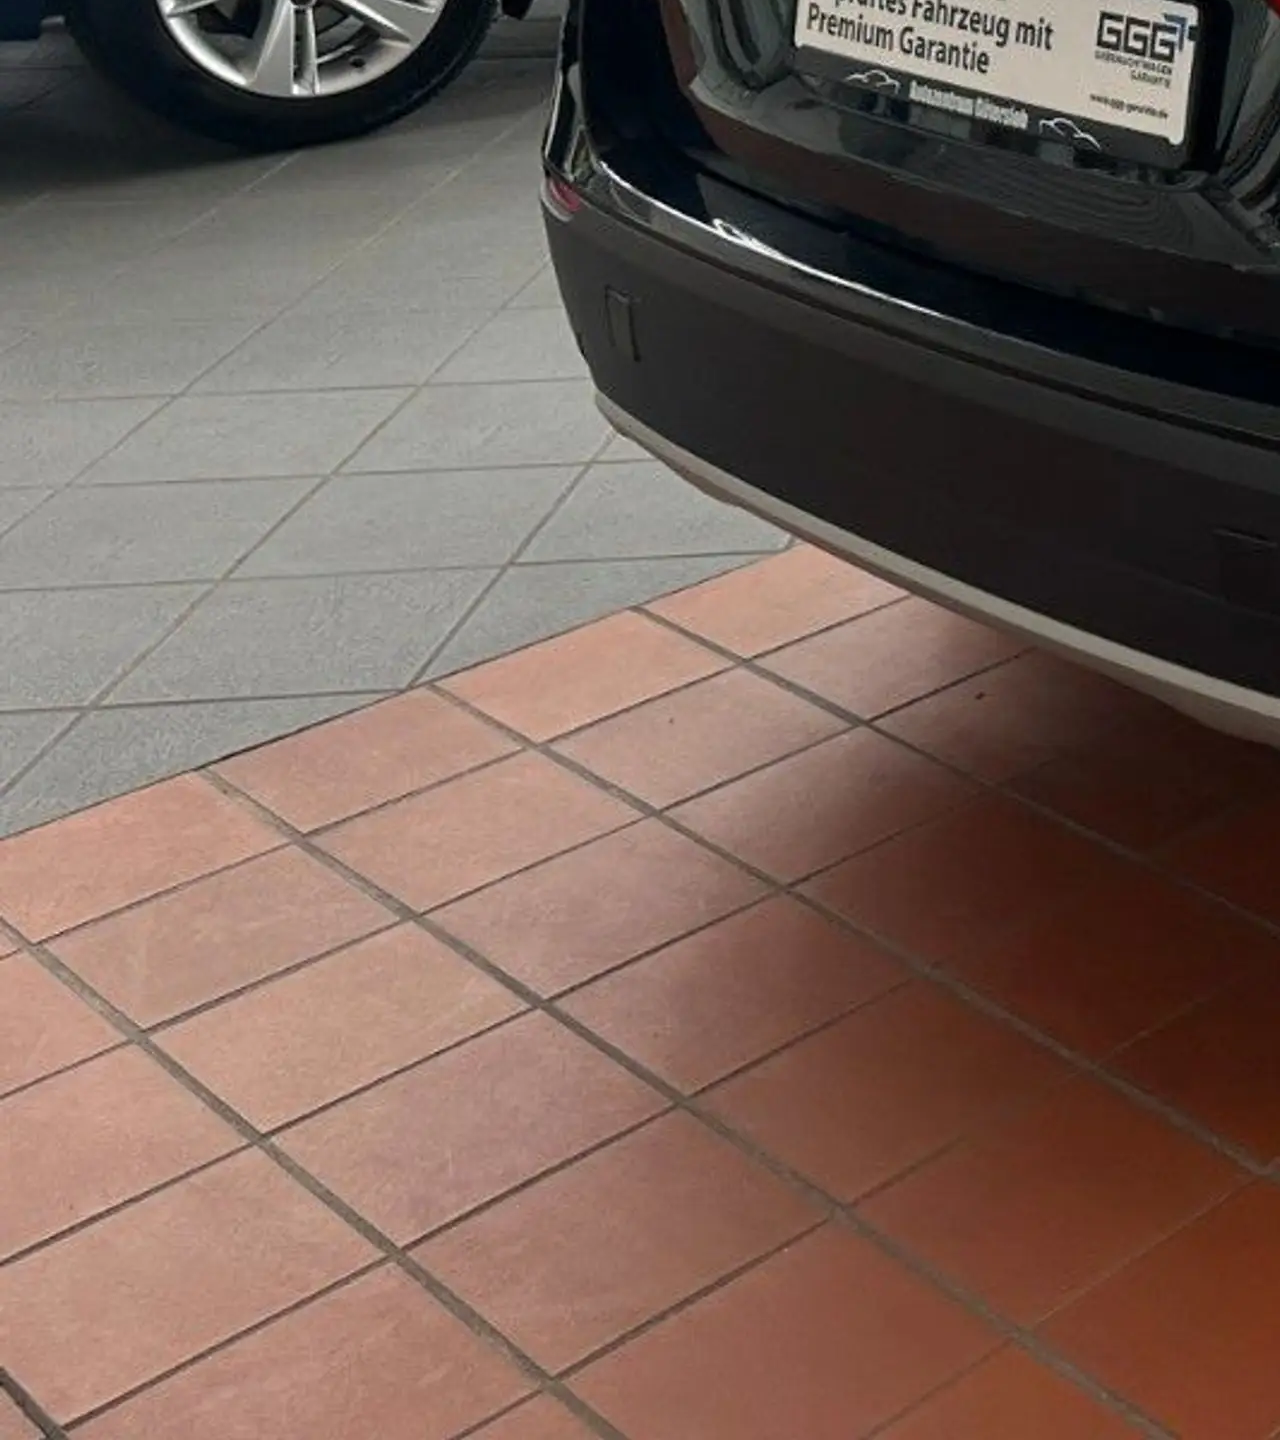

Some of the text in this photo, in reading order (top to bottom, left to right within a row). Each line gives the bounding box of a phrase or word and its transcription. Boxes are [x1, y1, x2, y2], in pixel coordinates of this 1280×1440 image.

[806, 2, 990, 74] Premium Garantie
[1016, 17, 1053, 51] mit
[1096, 11, 1176, 62] GGG
